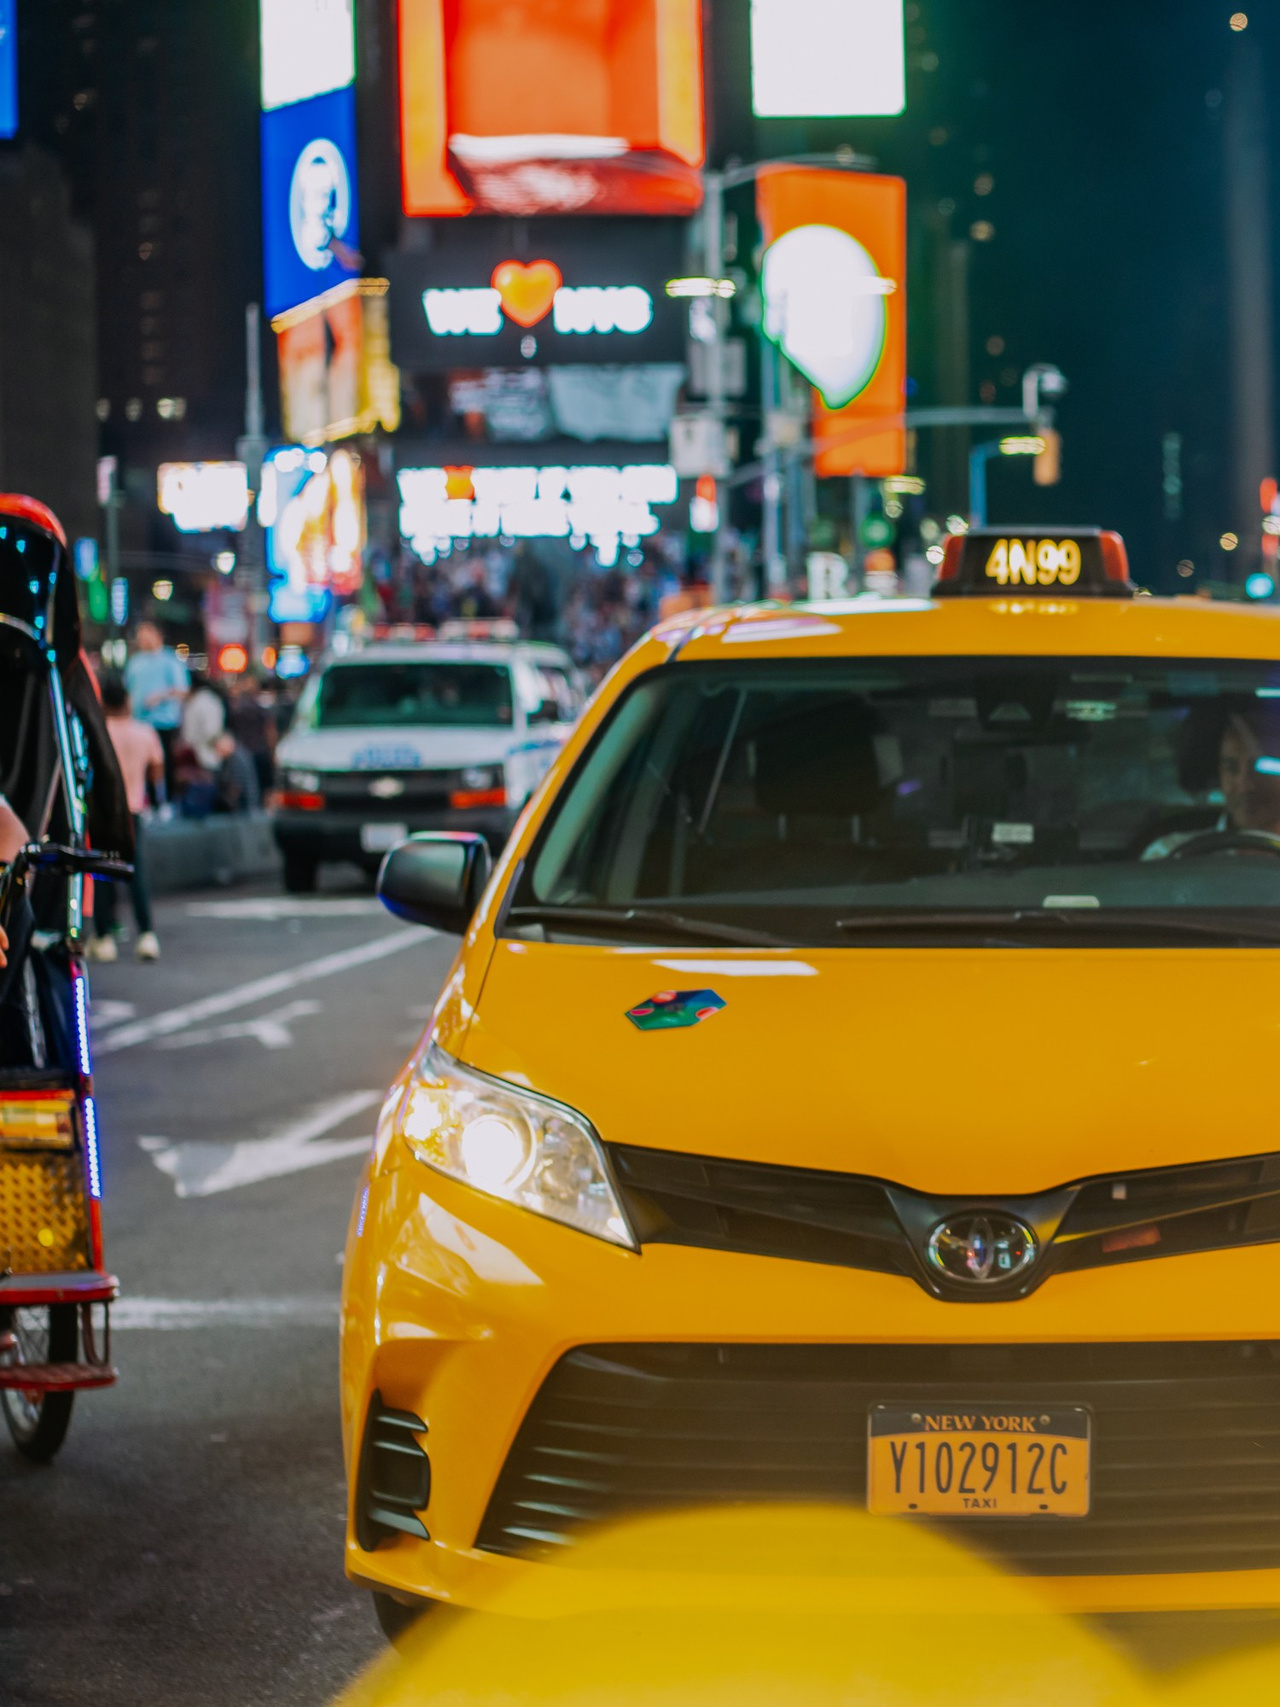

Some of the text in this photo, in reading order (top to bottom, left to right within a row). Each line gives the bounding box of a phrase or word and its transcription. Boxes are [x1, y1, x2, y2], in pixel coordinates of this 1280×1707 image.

[985, 538, 1081, 585] 4N99
[924, 1415, 1036, 1432] NEW YORK
[890, 1441, 1067, 1494] Y102912C
[963, 1498, 997, 1508] TAXI
